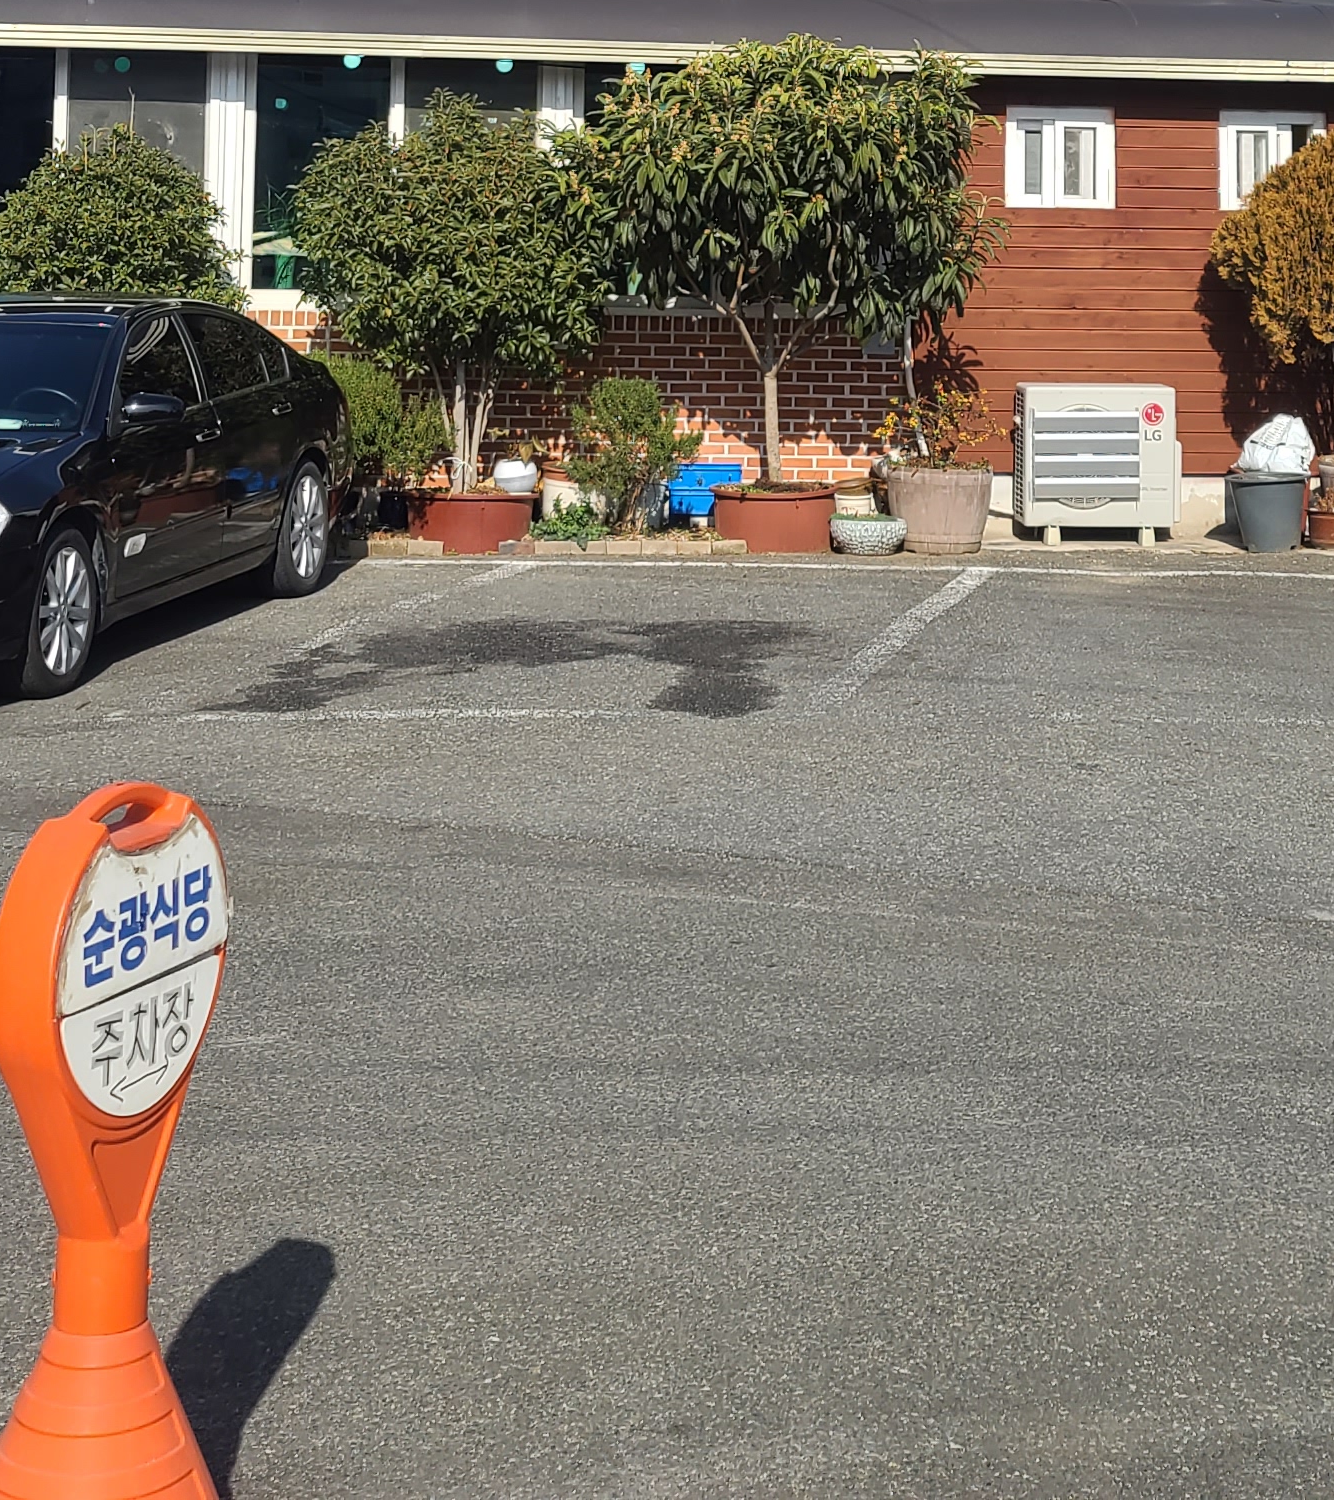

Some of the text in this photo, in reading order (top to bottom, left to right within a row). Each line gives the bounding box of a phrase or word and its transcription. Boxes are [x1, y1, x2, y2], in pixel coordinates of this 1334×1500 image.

[1144, 429, 1162, 442] LG
[83, 864, 213, 989] 순광식당
[90, 981, 195, 1088] 주차장
